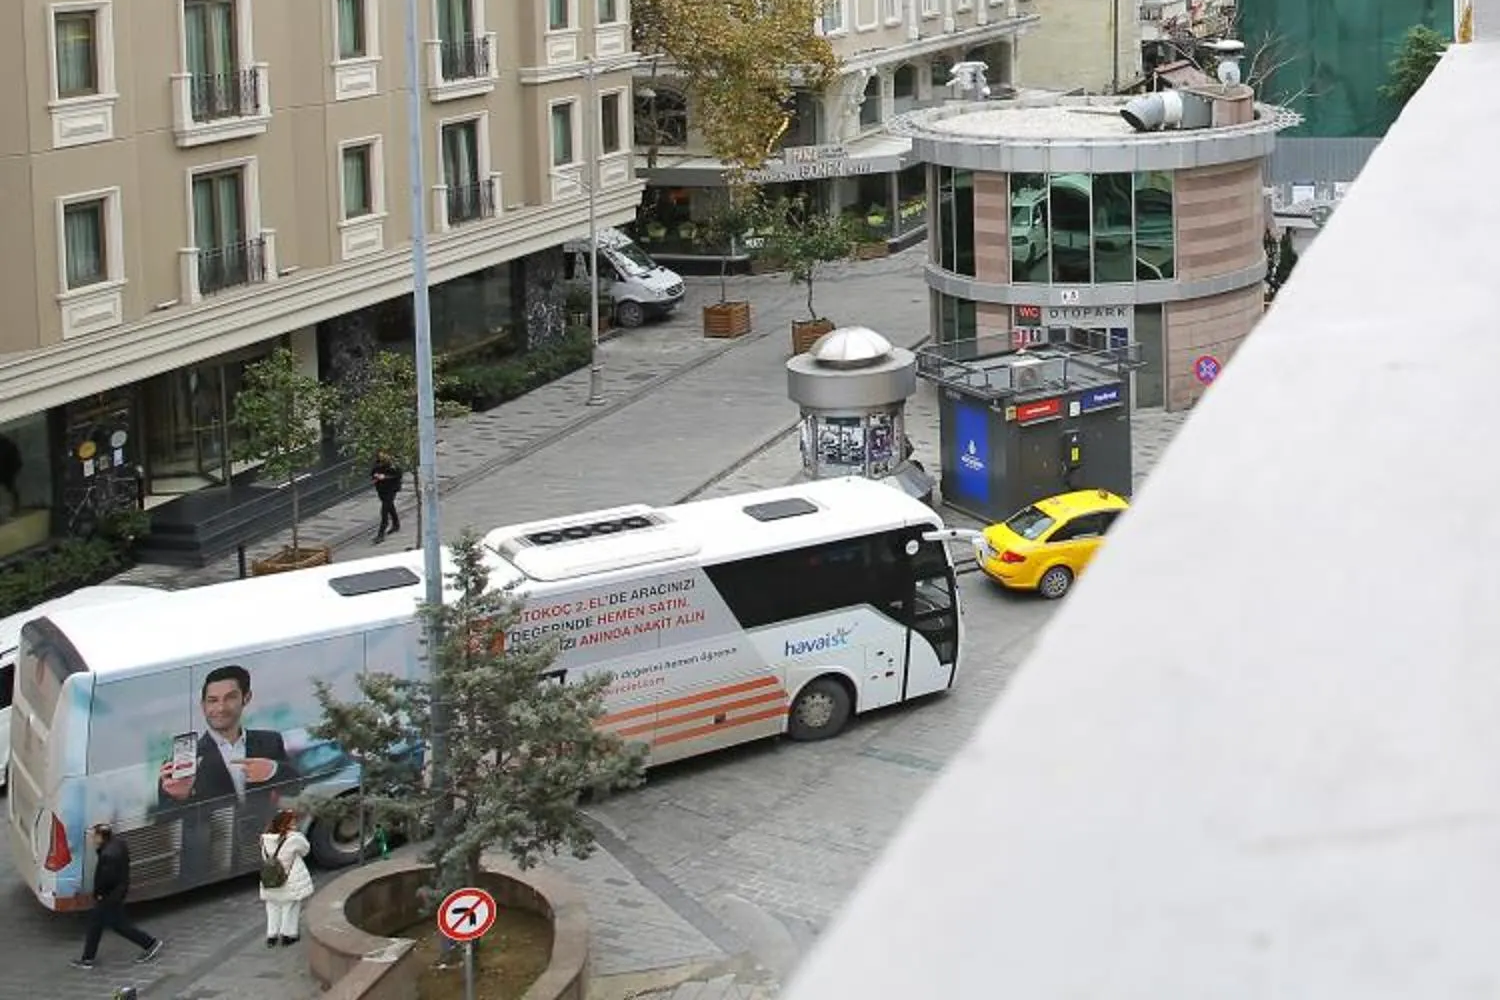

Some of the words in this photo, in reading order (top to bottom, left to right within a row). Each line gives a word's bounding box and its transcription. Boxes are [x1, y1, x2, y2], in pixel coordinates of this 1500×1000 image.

[1049, 306, 1126, 319] OTOPARK
[597, 605, 645, 625] HEMEN
[675, 609, 706, 627] ALIN
